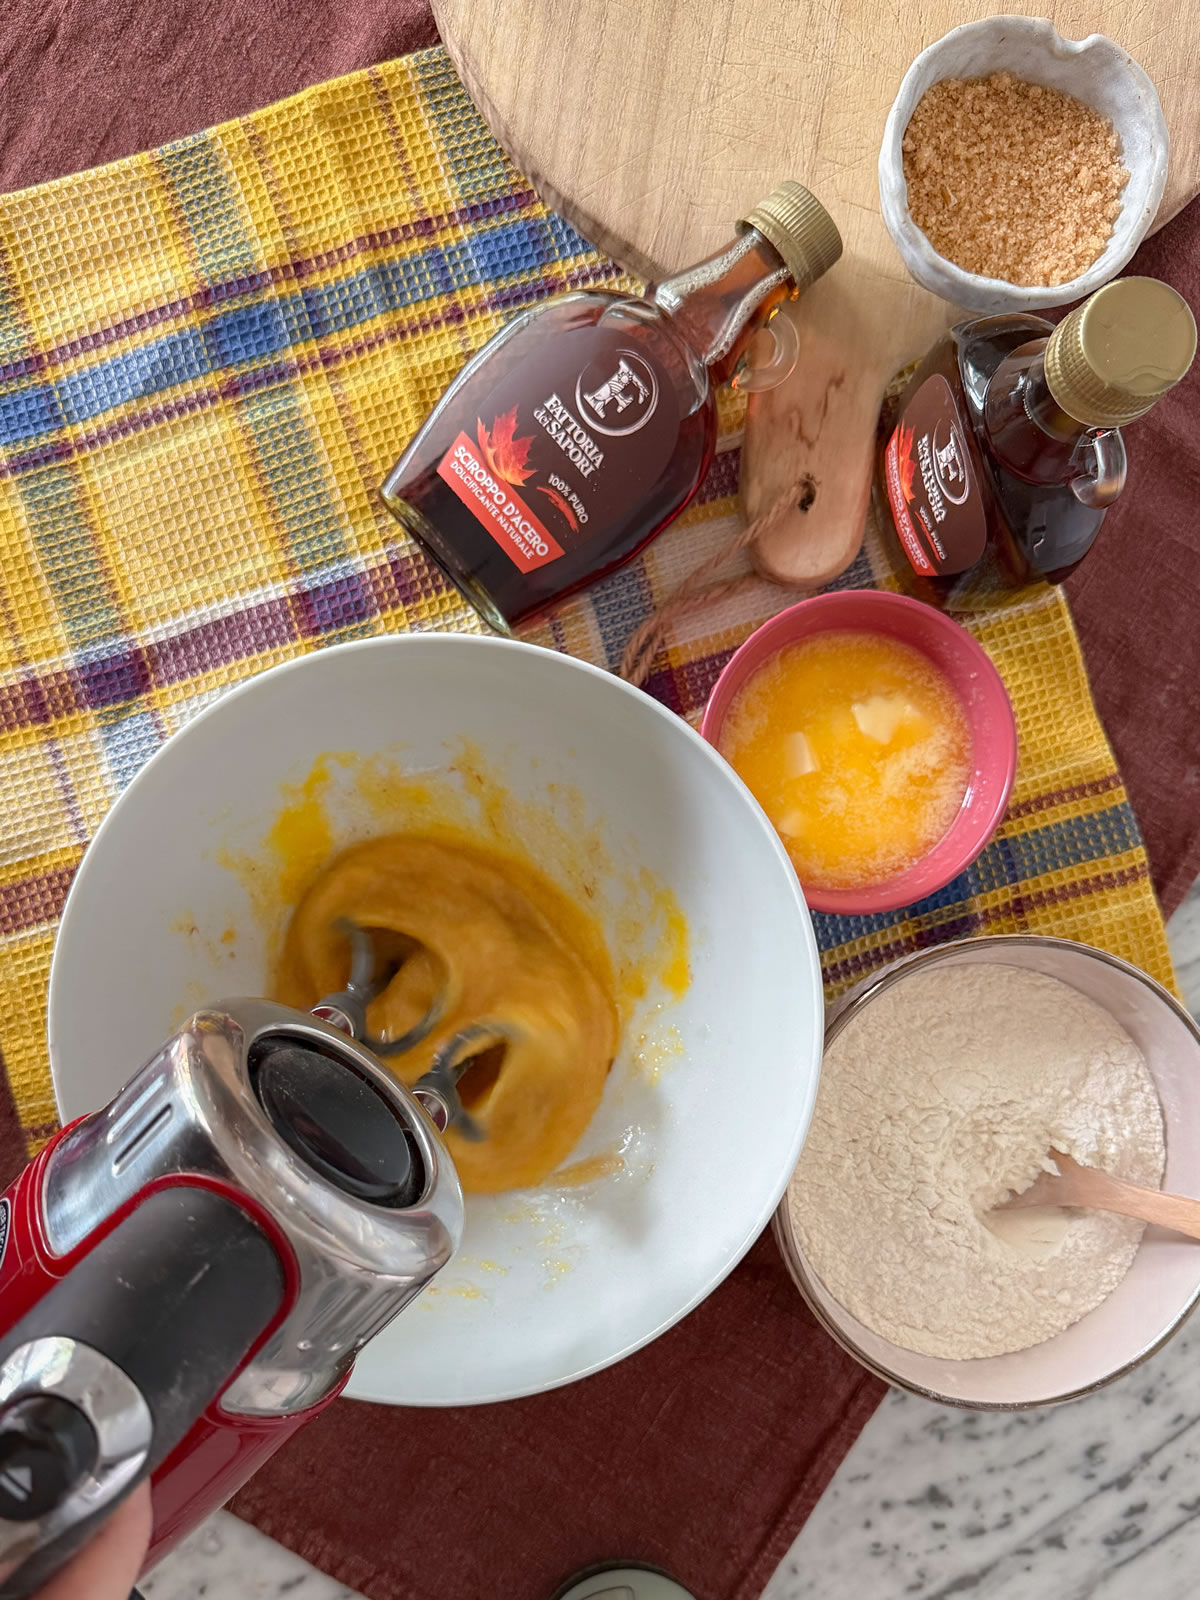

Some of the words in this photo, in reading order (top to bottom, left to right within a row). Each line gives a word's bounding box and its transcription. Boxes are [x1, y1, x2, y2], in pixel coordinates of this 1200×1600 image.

[533, 407, 552, 428] dei
[546, 420, 596, 478] SAPORI
[544, 393, 604, 469] FATTORIA
[450, 460, 500, 518] DOLCIFICANTE
[497, 516, 534, 559] NATURALE
[454, 446, 507, 505] SCIROPPO
[502, 502, 549, 556] D'ACERO
[548, 473, 572, 497] 100%
[568, 492, 589, 524] PURO
[921, 433, 946, 521] FATTORIA
[901, 511, 928, 569] D'ACERO
[931, 531, 946, 560] PURO
